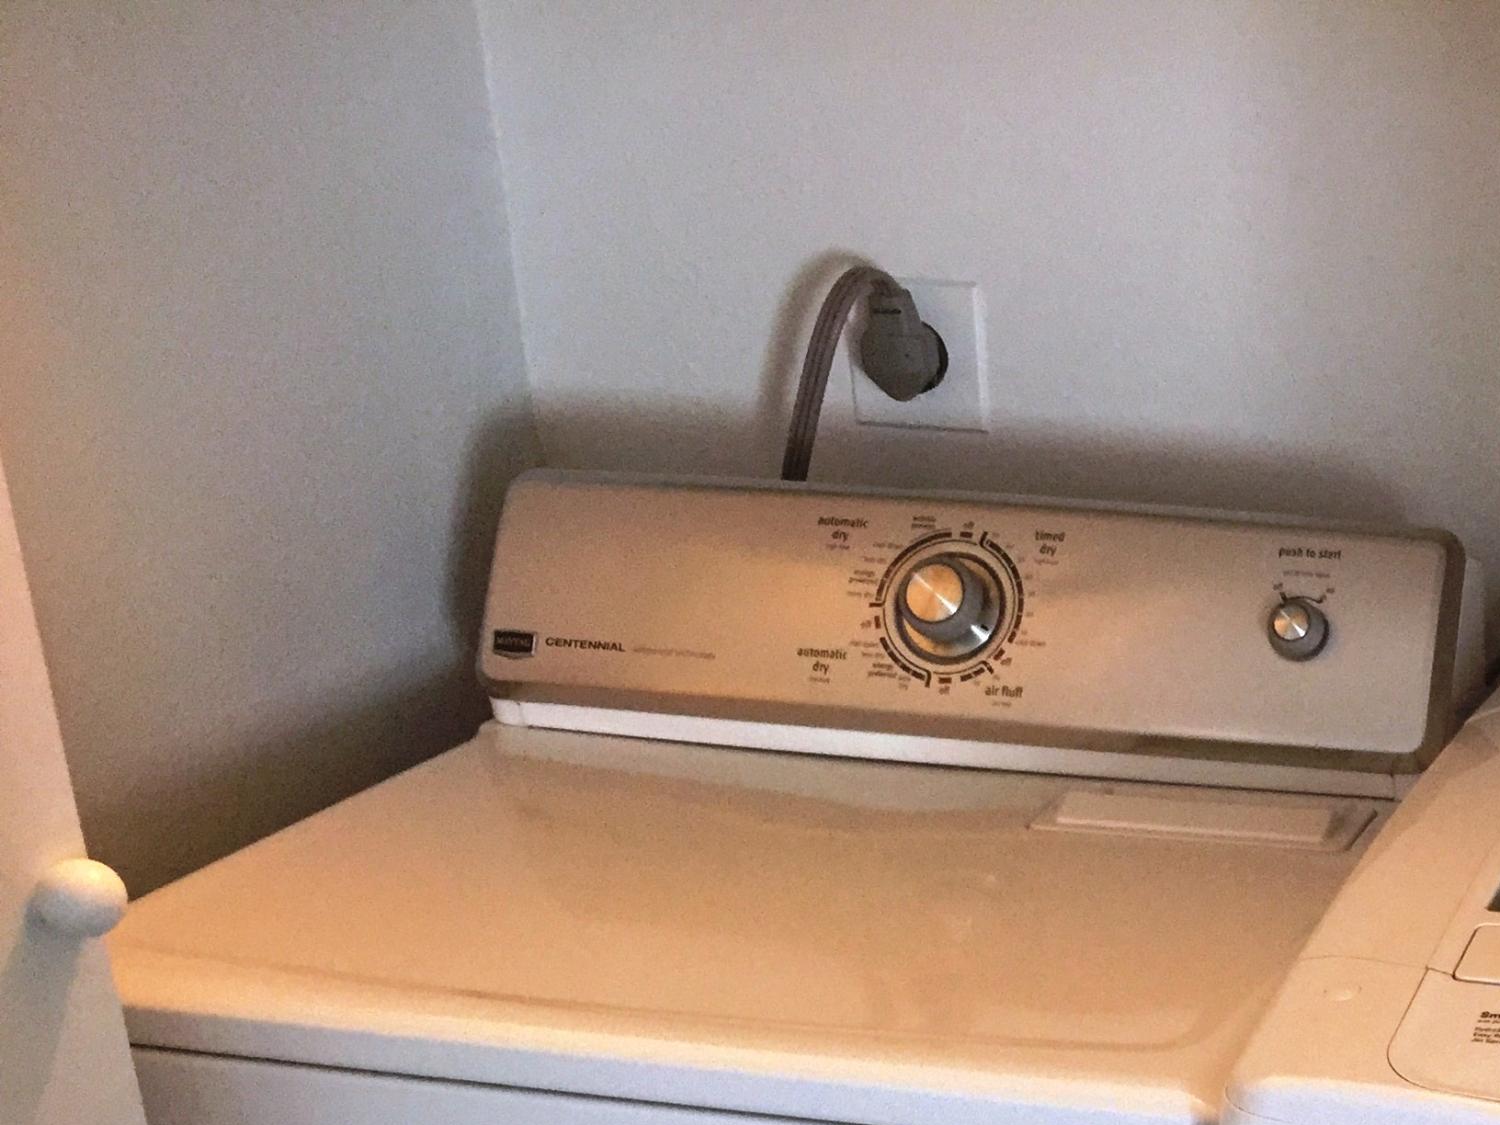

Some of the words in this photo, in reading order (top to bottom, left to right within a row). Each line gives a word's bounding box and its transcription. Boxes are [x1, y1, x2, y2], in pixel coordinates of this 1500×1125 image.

[817, 516, 869, 528] automatic
[831, 530, 849, 542] dry
[1035, 529, 1066, 542] timed
[1039, 543, 1057, 556] dry
[1278, 547, 1303, 559] push
[1306, 548, 1317, 558] to
[1318, 549, 1341, 560] start
[545, 637, 626, 652] CENTENNIAL
[797, 647, 847, 660] automatic
[812, 660, 829, 675] dry
[985, 685, 1000, 696] air
[1001, 685, 1023, 698] fluff
